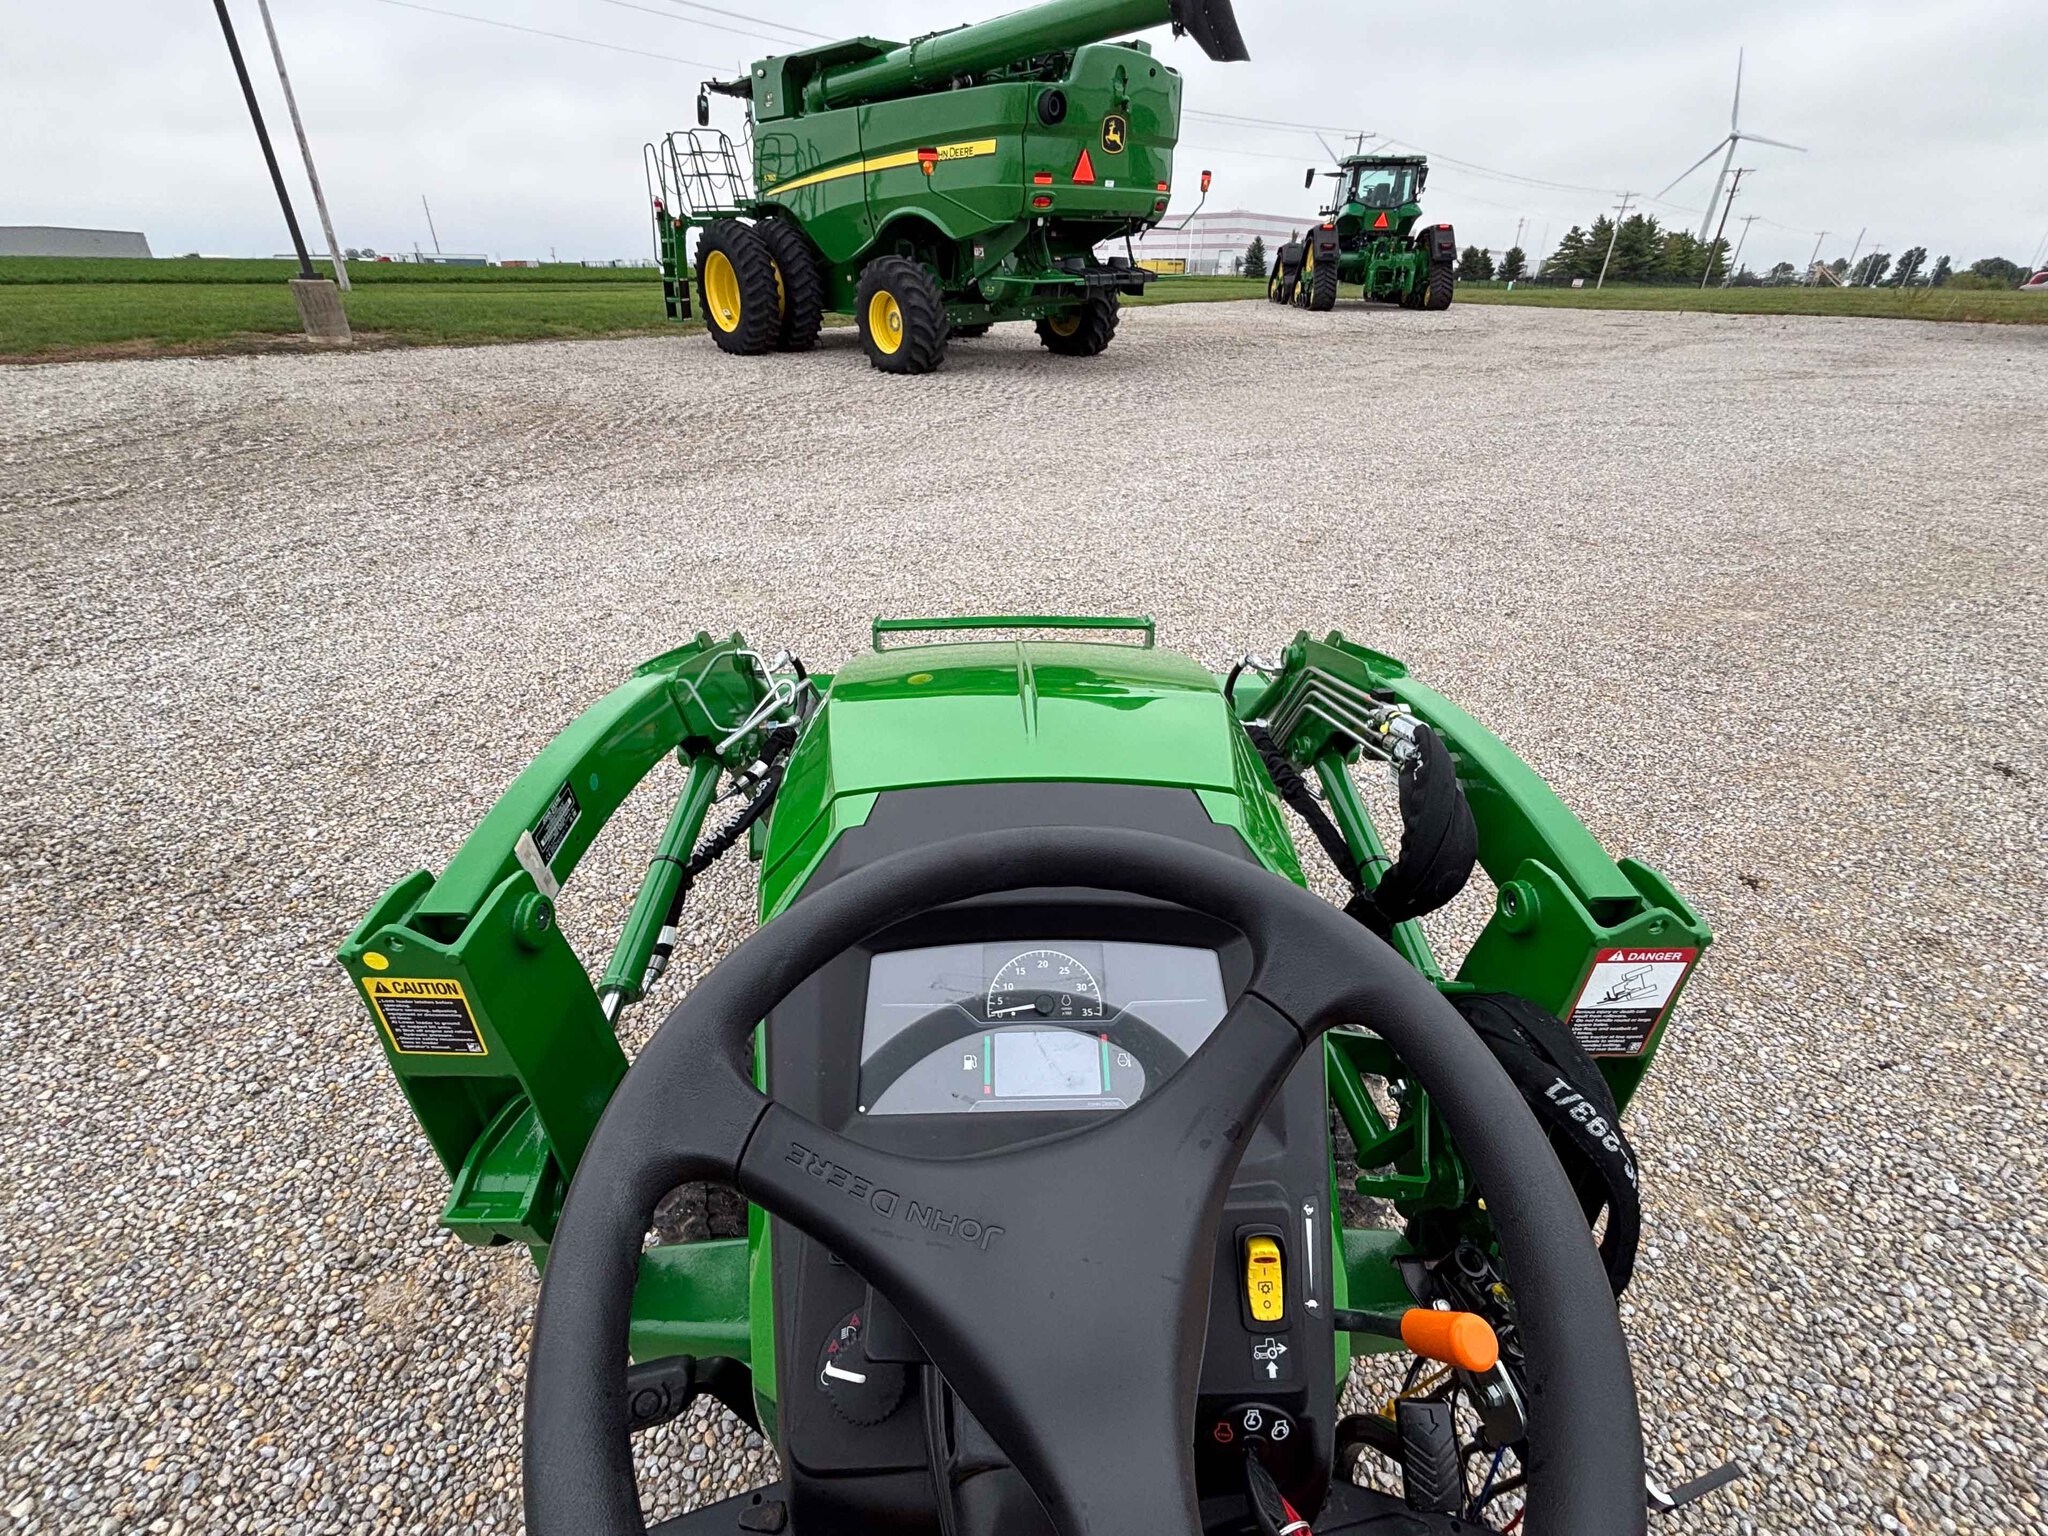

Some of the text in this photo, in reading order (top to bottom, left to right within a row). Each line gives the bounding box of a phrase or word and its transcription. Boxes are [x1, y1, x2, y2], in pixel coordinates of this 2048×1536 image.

[950, 146, 974, 158] DEERE
[1627, 952, 1682, 960] DANGER
[392, 982, 459, 995] CAUTION
[784, 1142, 1006, 1250] JOHN DEERE
